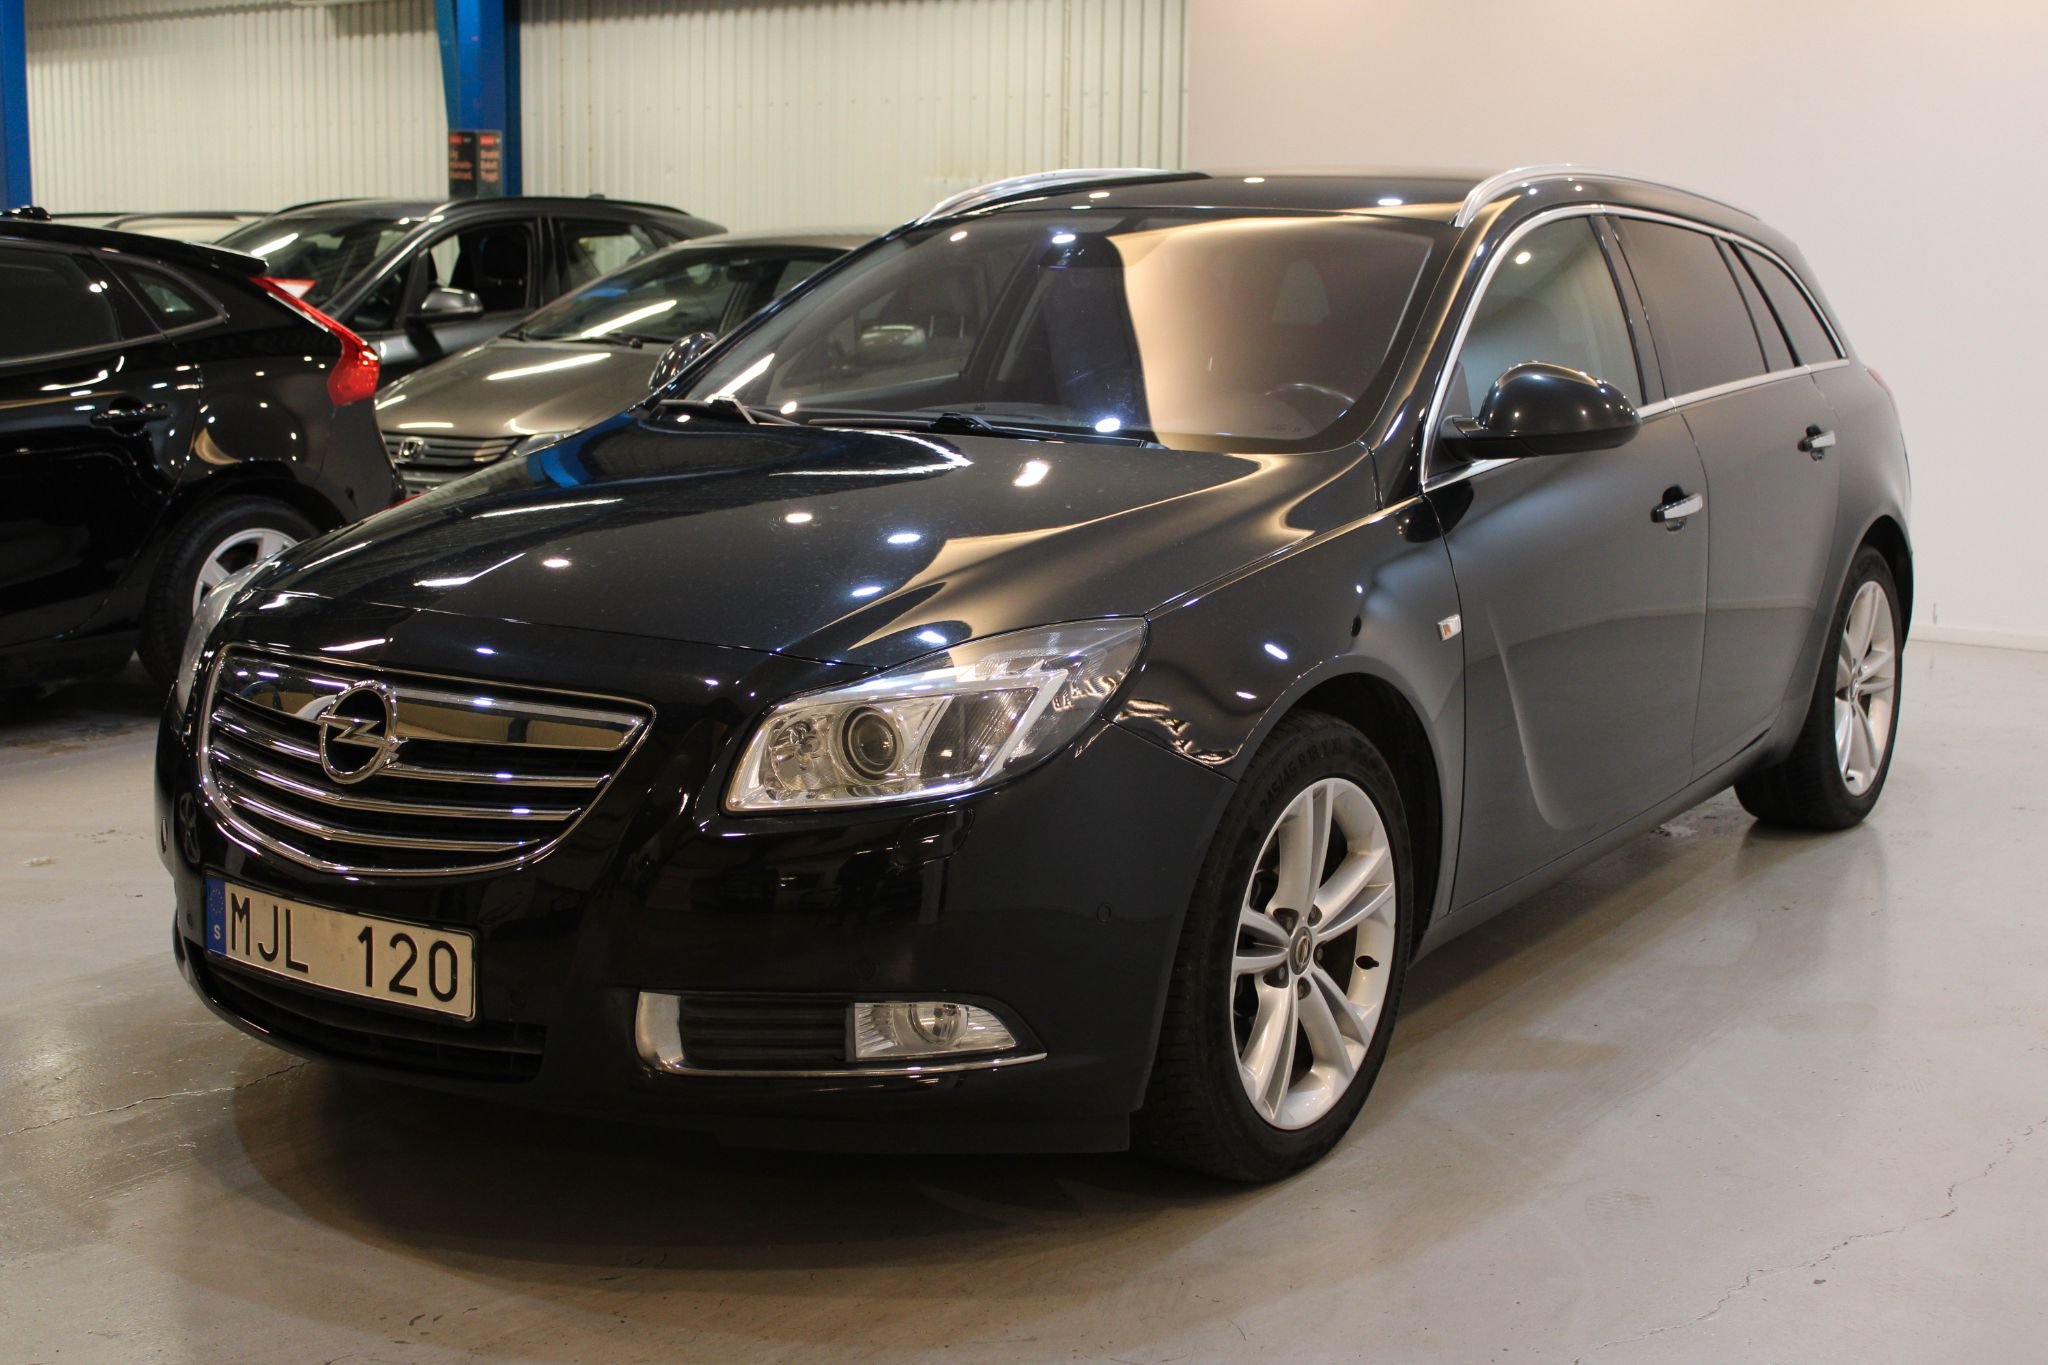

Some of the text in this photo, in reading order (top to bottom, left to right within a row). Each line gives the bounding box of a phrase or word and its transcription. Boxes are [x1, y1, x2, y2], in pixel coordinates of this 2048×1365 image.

[213, 924, 221, 940] S
[231, 892, 458, 1002] MJL 120
